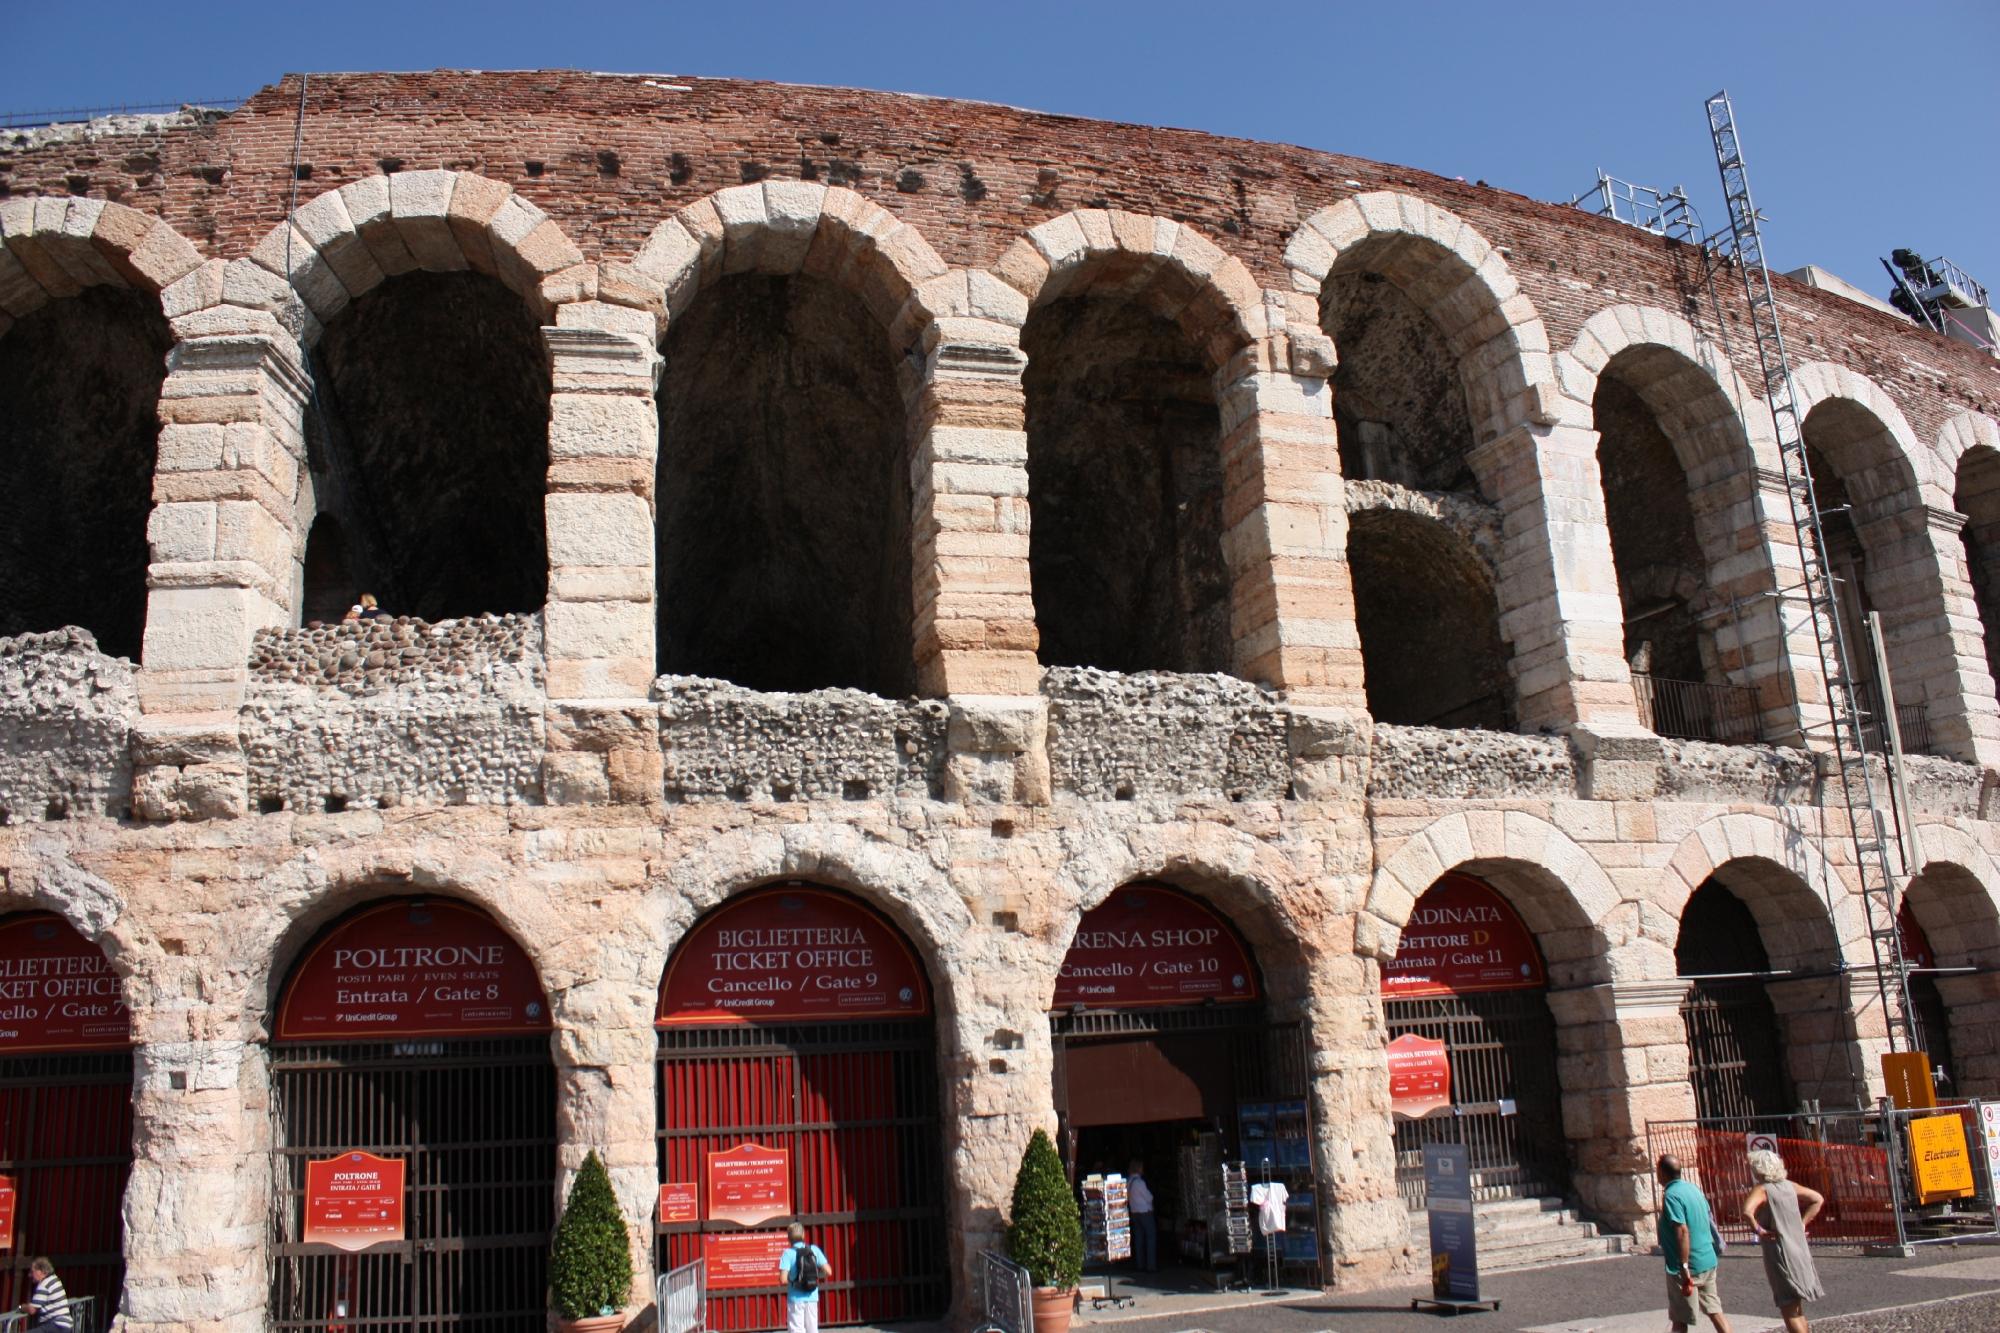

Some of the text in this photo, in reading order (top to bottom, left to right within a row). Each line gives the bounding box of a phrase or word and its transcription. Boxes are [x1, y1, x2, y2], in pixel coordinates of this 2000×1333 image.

[718, 928, 866, 948] BIGLIETTERIA
[1152, 928, 1219, 948] SHOP
[1473, 930, 1490, 945] D
[0, 956, 113, 977] LIETTERIA
[333, 946, 504, 969] POLTRONE
[712, 949, 873, 971] TICKET OFFICE
[1386, 949, 1502, 970] Entrata / Gate 11
[337, 971, 500, 983] POSTI PARI / EVEN SEATS
[1060, 958, 1219, 978] Cancello / Gate 10
[44, 977, 122, 998] OFFICE
[708, 973, 878, 993] Cancello / Gate 9
[336, 985, 499, 1004] Entrata / Gate 8
[724, 998, 775, 1008] UniCredit Group
[45, 1003, 55, 1020] /
[62, 1003, 108, 1017] Gate
[113, 1000, 126, 1016] 7
[345, 1012, 397, 1022] UniCredit Group
[334, 1172, 378, 1180] POLTRONE
